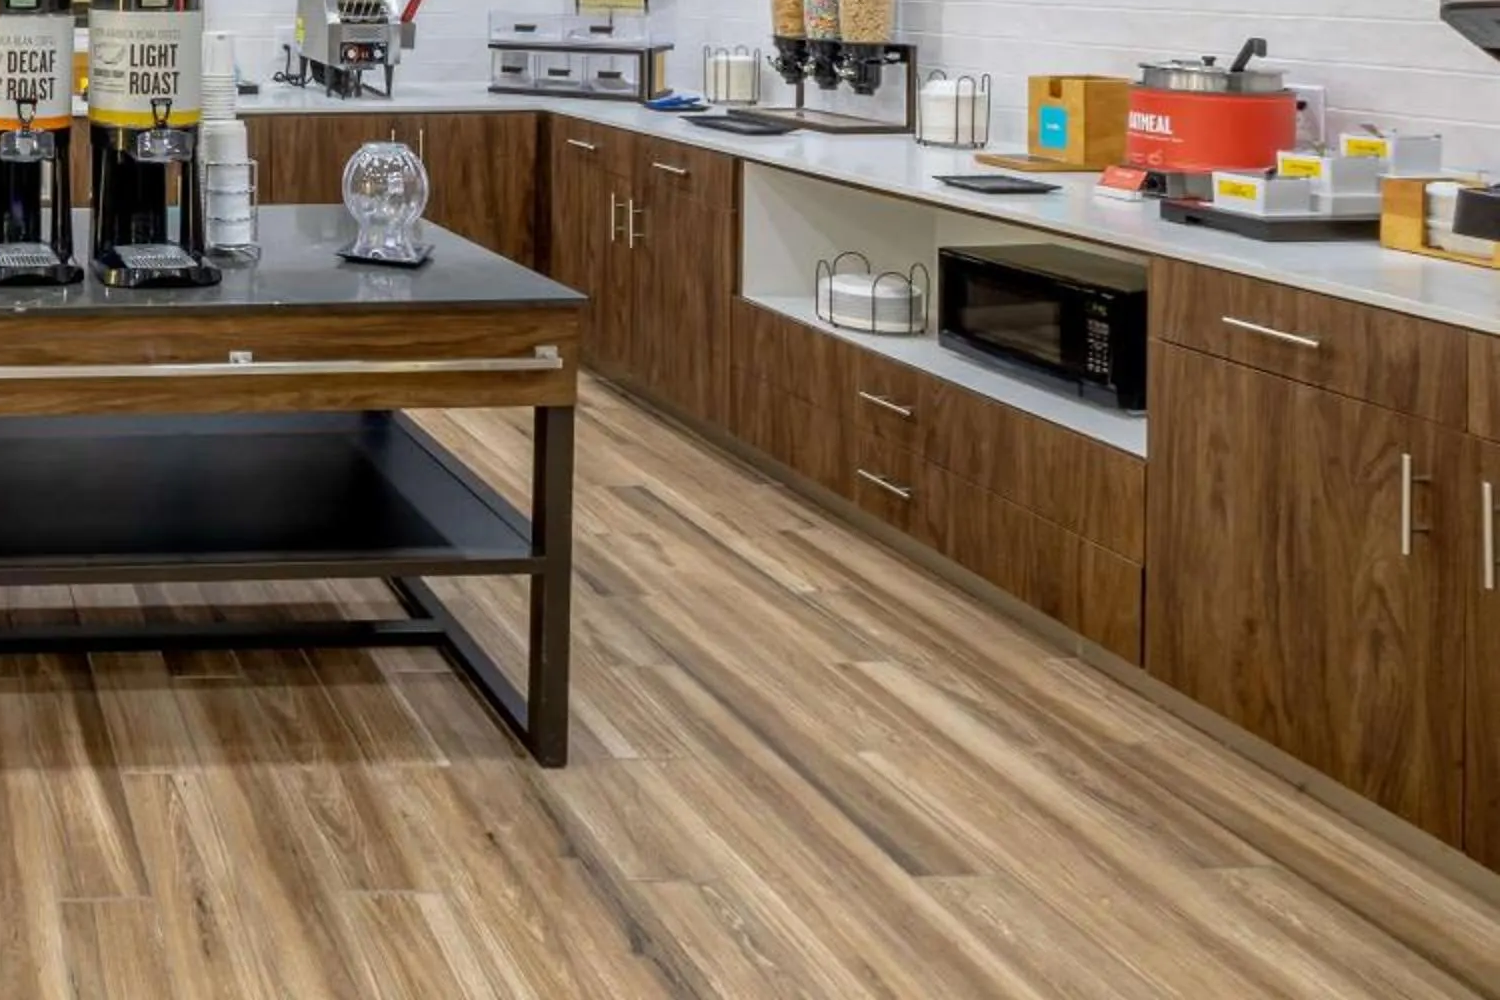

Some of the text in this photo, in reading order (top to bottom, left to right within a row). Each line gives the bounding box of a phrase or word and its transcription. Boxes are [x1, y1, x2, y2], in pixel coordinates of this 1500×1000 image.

[7, 50, 57, 73] DECAF
[129, 43, 178, 67] LIGHT
[7, 77, 57, 100] ROAST
[129, 71, 180, 95] ROAST
[1128, 111, 1173, 135] ATMEAL
